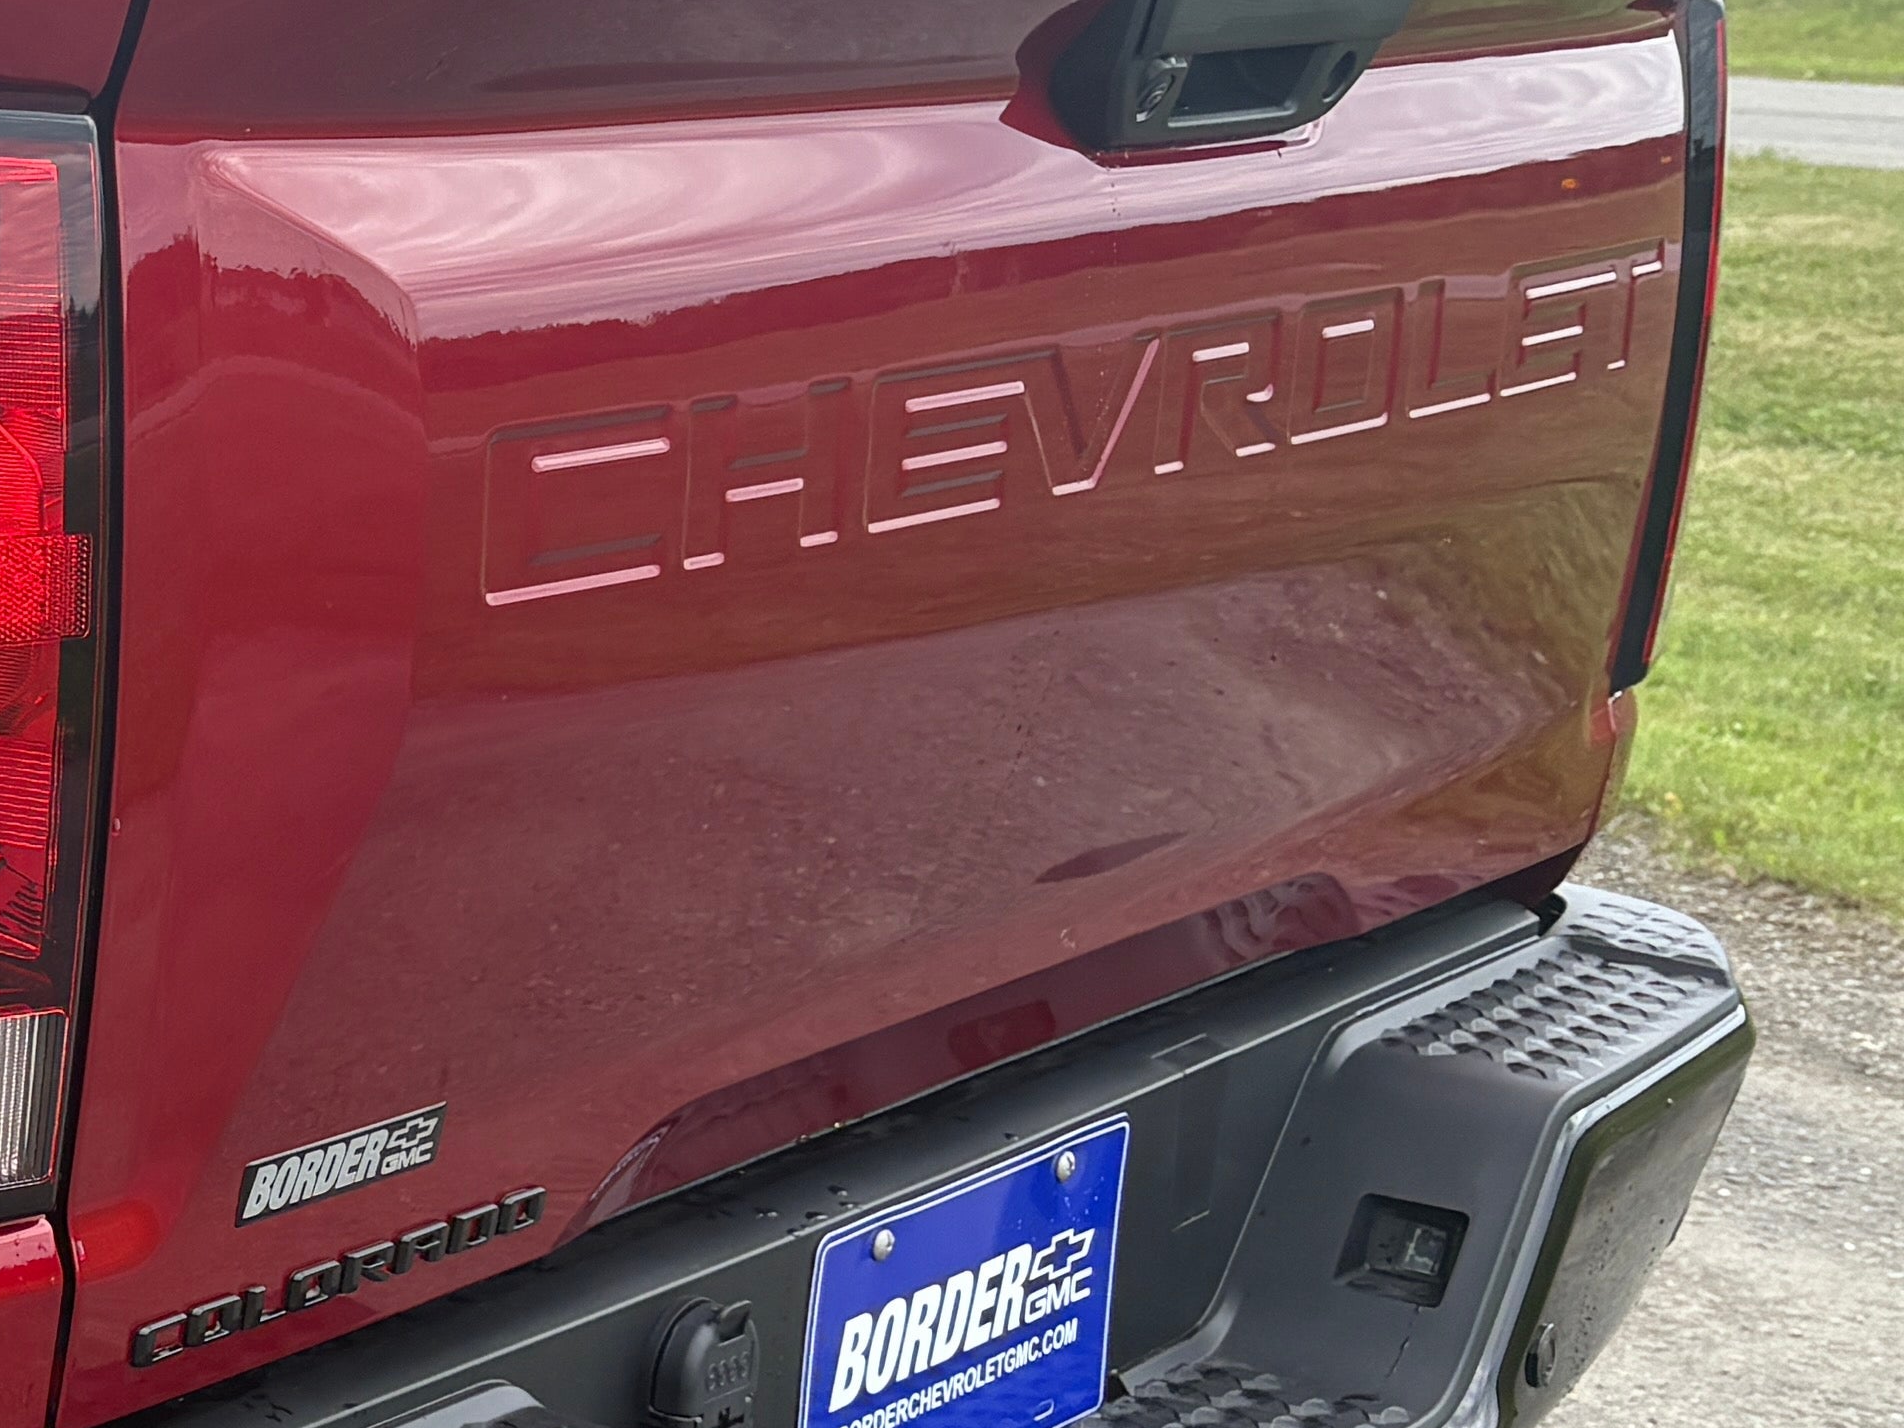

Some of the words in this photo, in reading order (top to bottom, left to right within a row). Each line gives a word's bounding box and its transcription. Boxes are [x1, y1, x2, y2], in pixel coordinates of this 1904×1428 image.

[482, 238, 1667, 608] CHEVROLET
[243, 1129, 389, 1220] BORDER
[380, 1140, 433, 1177] GMC
[130, 1185, 548, 1369] COLORADO
[828, 1243, 1034, 1413] BORDER
[1023, 1267, 1093, 1325] GMC
